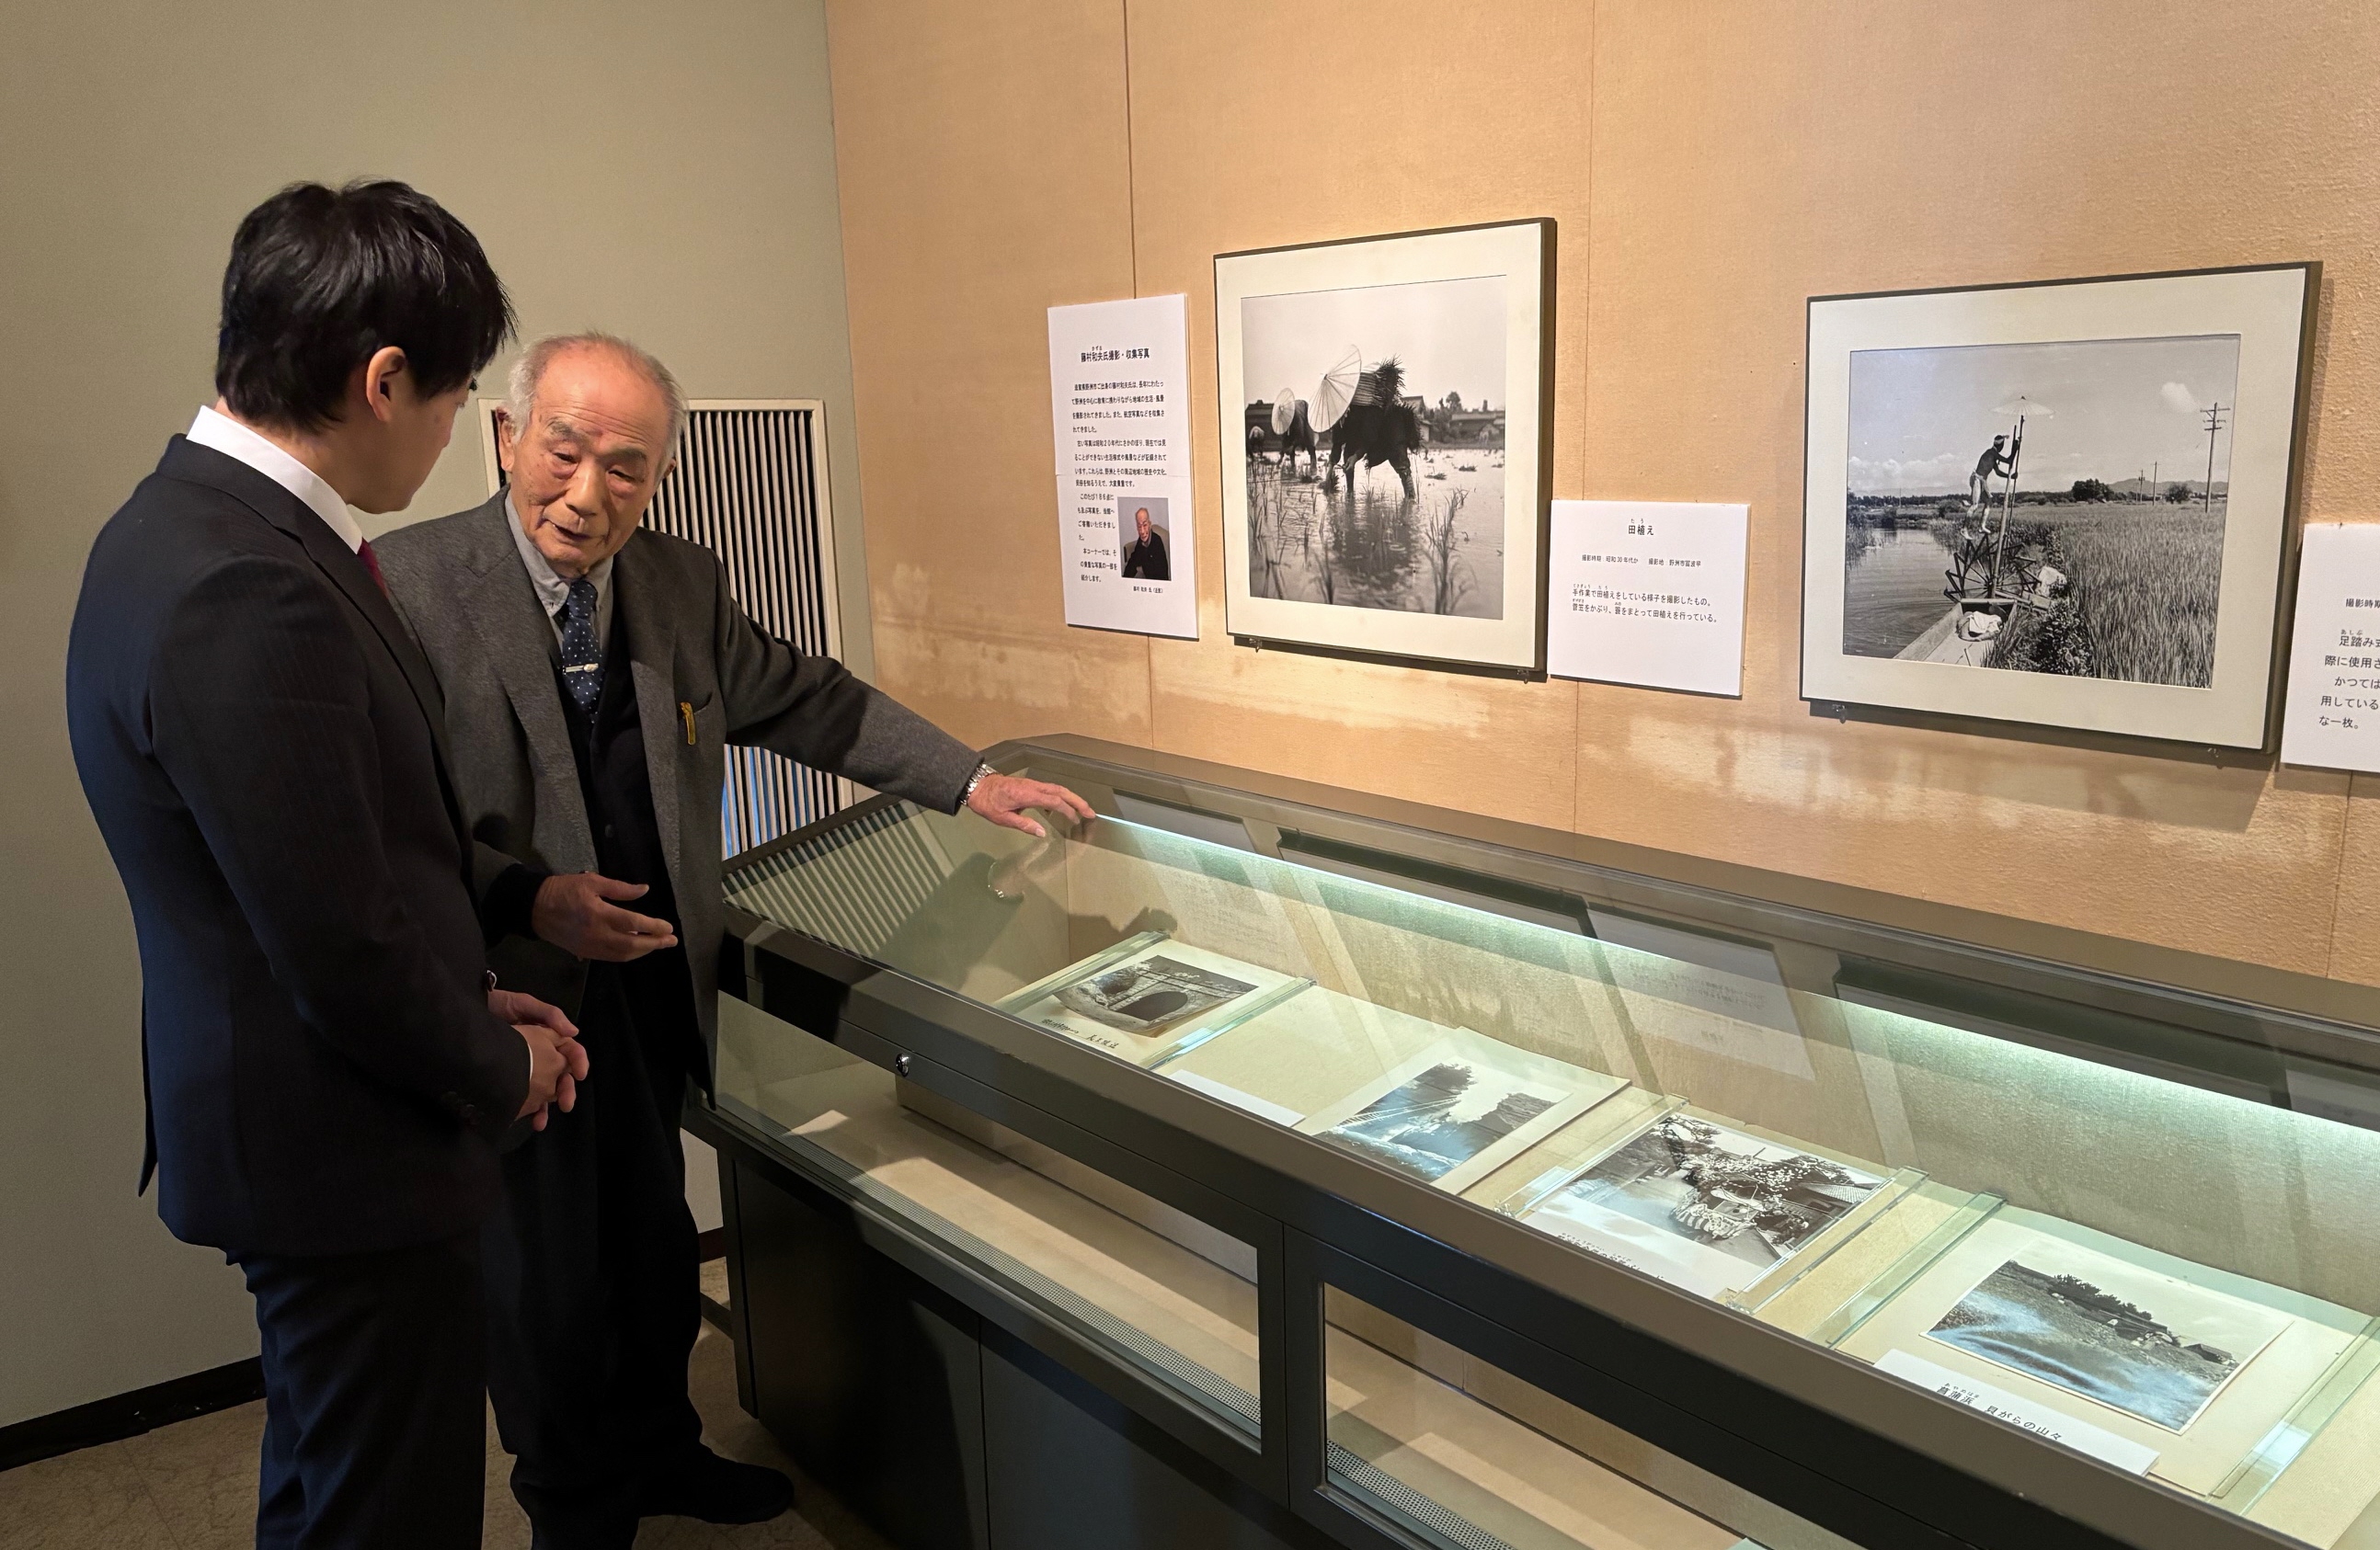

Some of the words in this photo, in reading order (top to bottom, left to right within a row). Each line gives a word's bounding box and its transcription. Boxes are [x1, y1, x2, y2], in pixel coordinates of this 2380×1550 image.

[1628, 524, 1654, 536] 田植え
[1573, 588, 1711, 607] 手作業で田植えをしている様子を撮影したもの。
[2334, 676, 2380, 690] かつては
[2320, 695, 2379, 711] 用している
[2318, 715, 2359, 730] な一枚。
